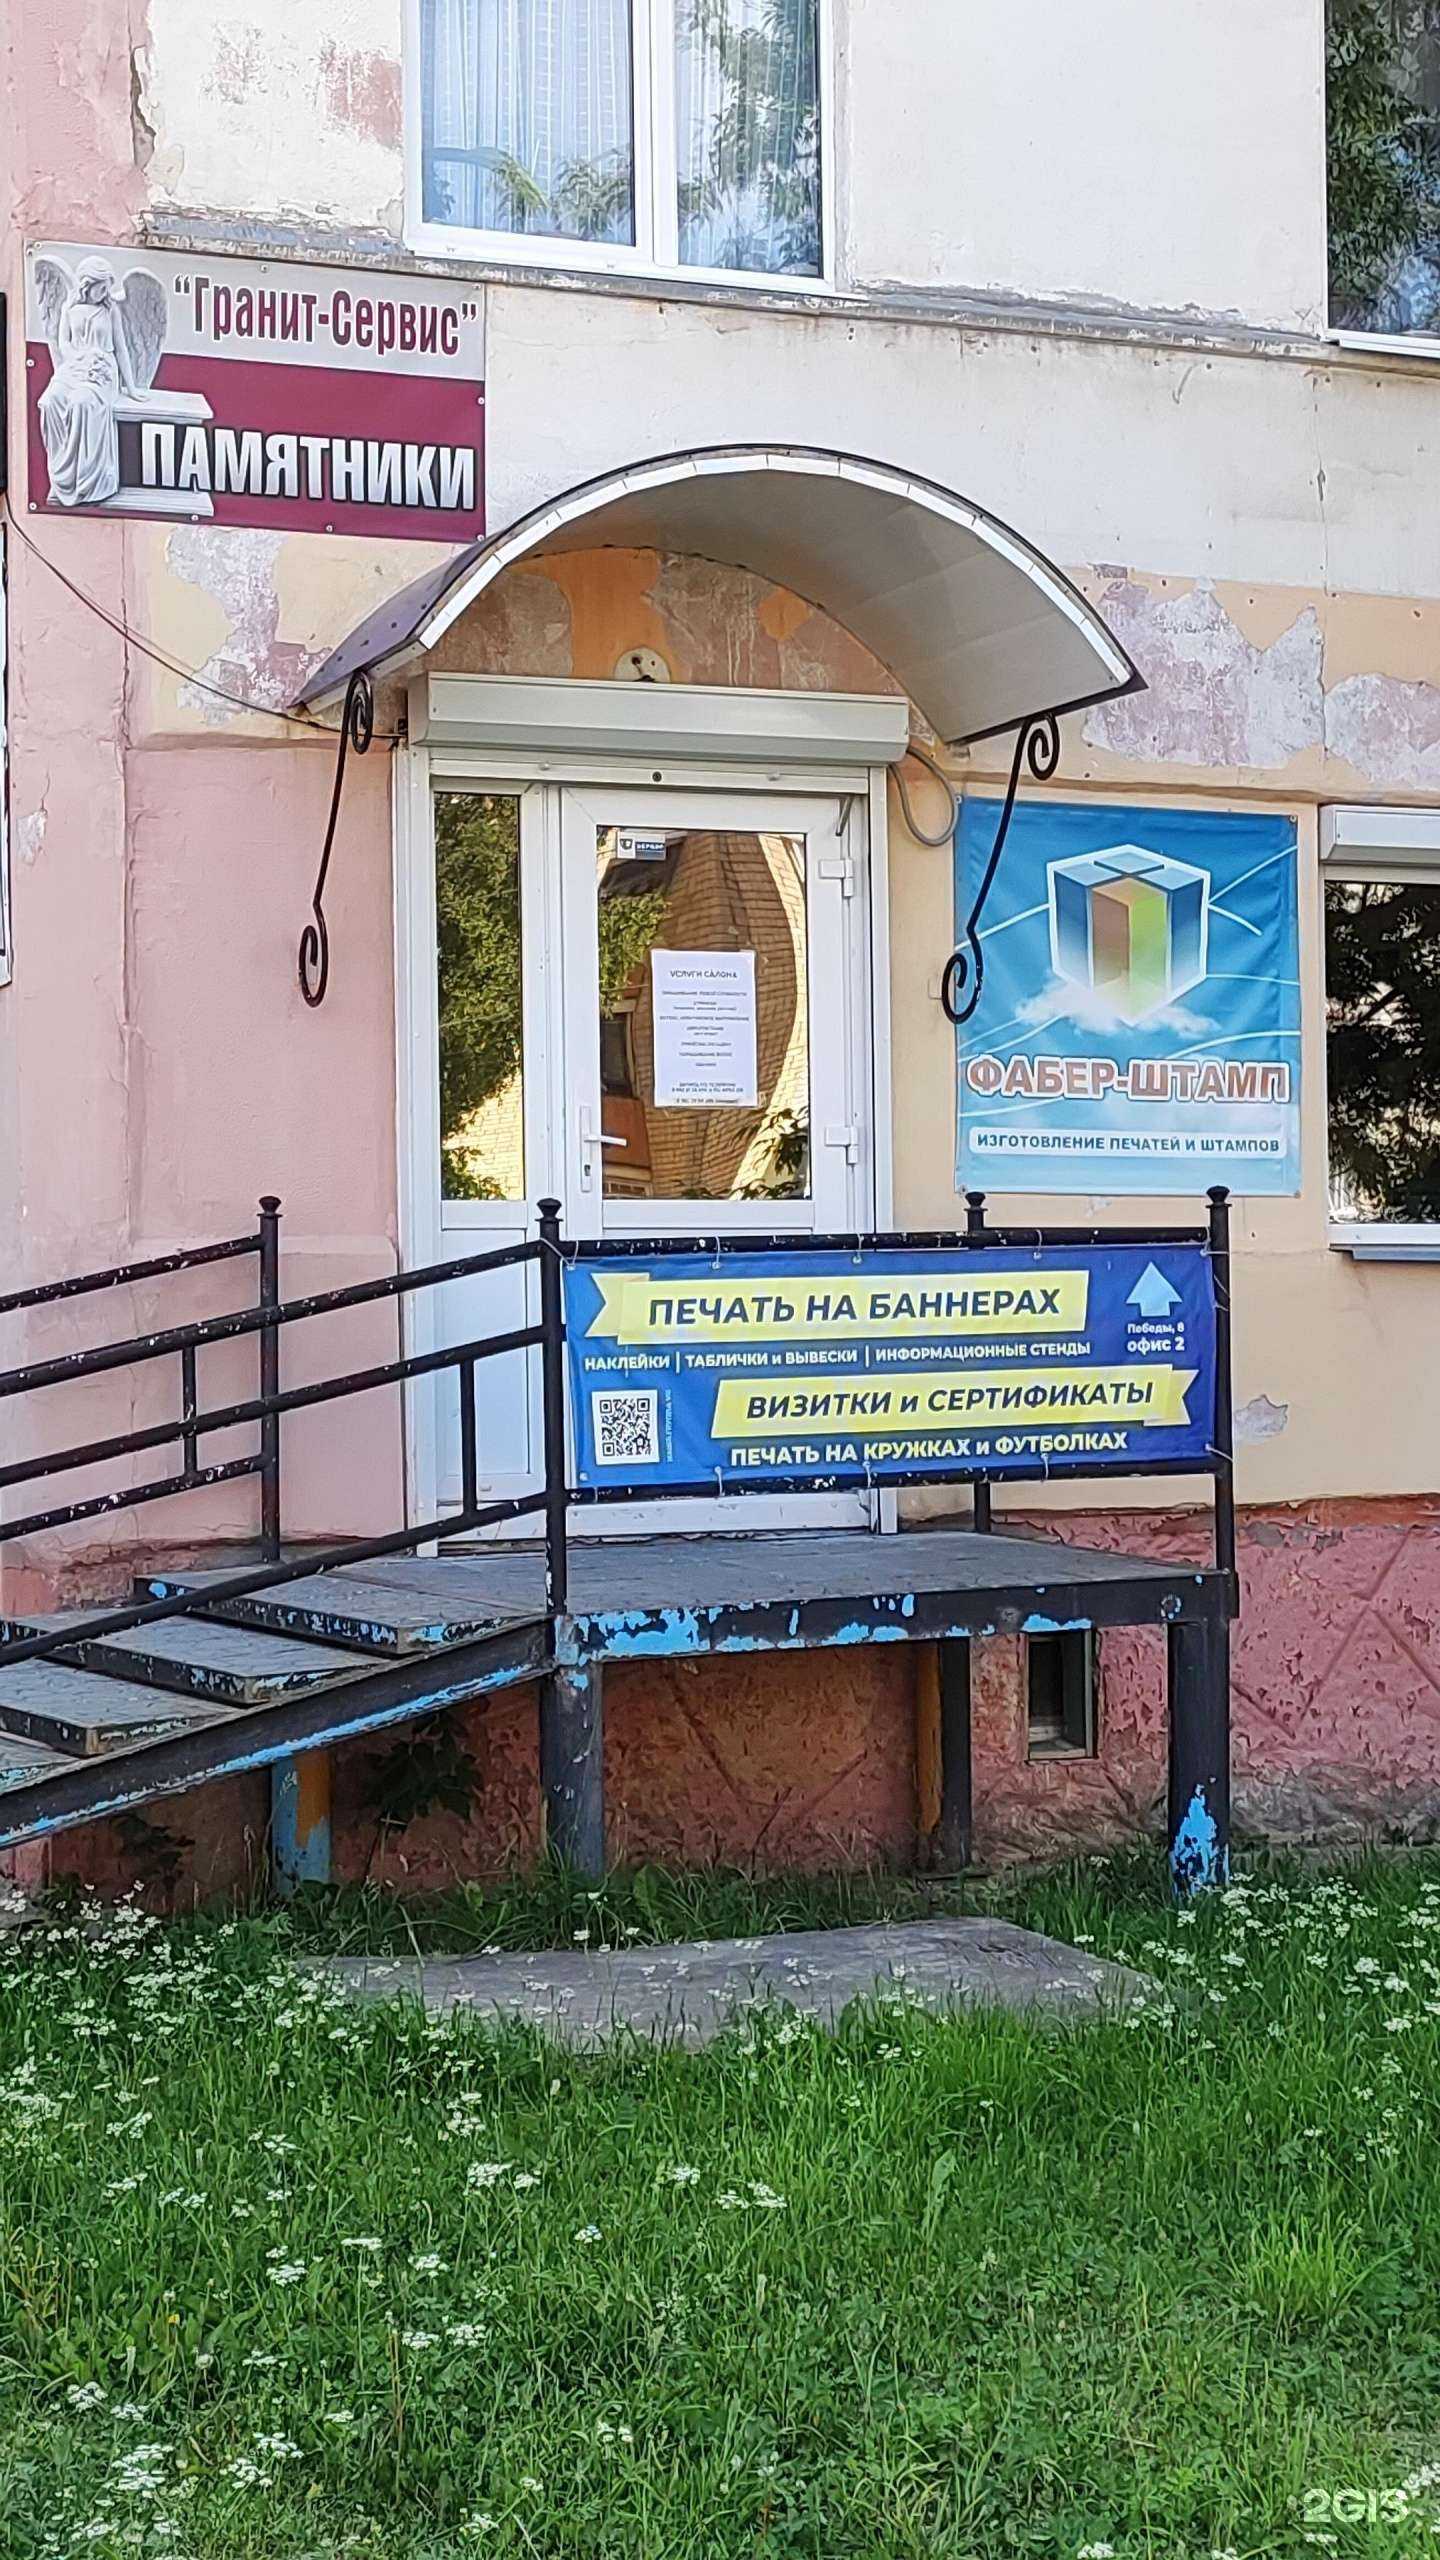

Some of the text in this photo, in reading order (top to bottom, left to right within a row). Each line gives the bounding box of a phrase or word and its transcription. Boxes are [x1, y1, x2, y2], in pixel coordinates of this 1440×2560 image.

[140, 421, 476, 510] ПАМЯТНИКИ
[967, 1056, 1289, 1101] ФАБЕР-ШТАМП
[977, 1134, 1280, 1152] ИЗГОТОВЛЕНИЕ ПЕЧАТЕЙ И ШТАМПОВ
[649, 1288, 1061, 1326] ПЕЧАТЬ НА БАННЕРАХ
[1128, 1321, 1185, 1334] Победы, 8
[585, 1341, 1091, 1371] НАКЛЕЙКИ ТАБЛИЧКИ и ВЫВЕСКИ ИНФОРМАЦИОННЫЕ СТЕНДЫ
[1127, 1336, 1185, 1355] офис 2
[747, 1382, 1154, 1419] ВИЗИТКИ и СЕРТИФИКАТЫ
[731, 1432, 1128, 1466] ПЕЧАТЬ НА КРУЖКАХ и ФУТБОЛКАХ
